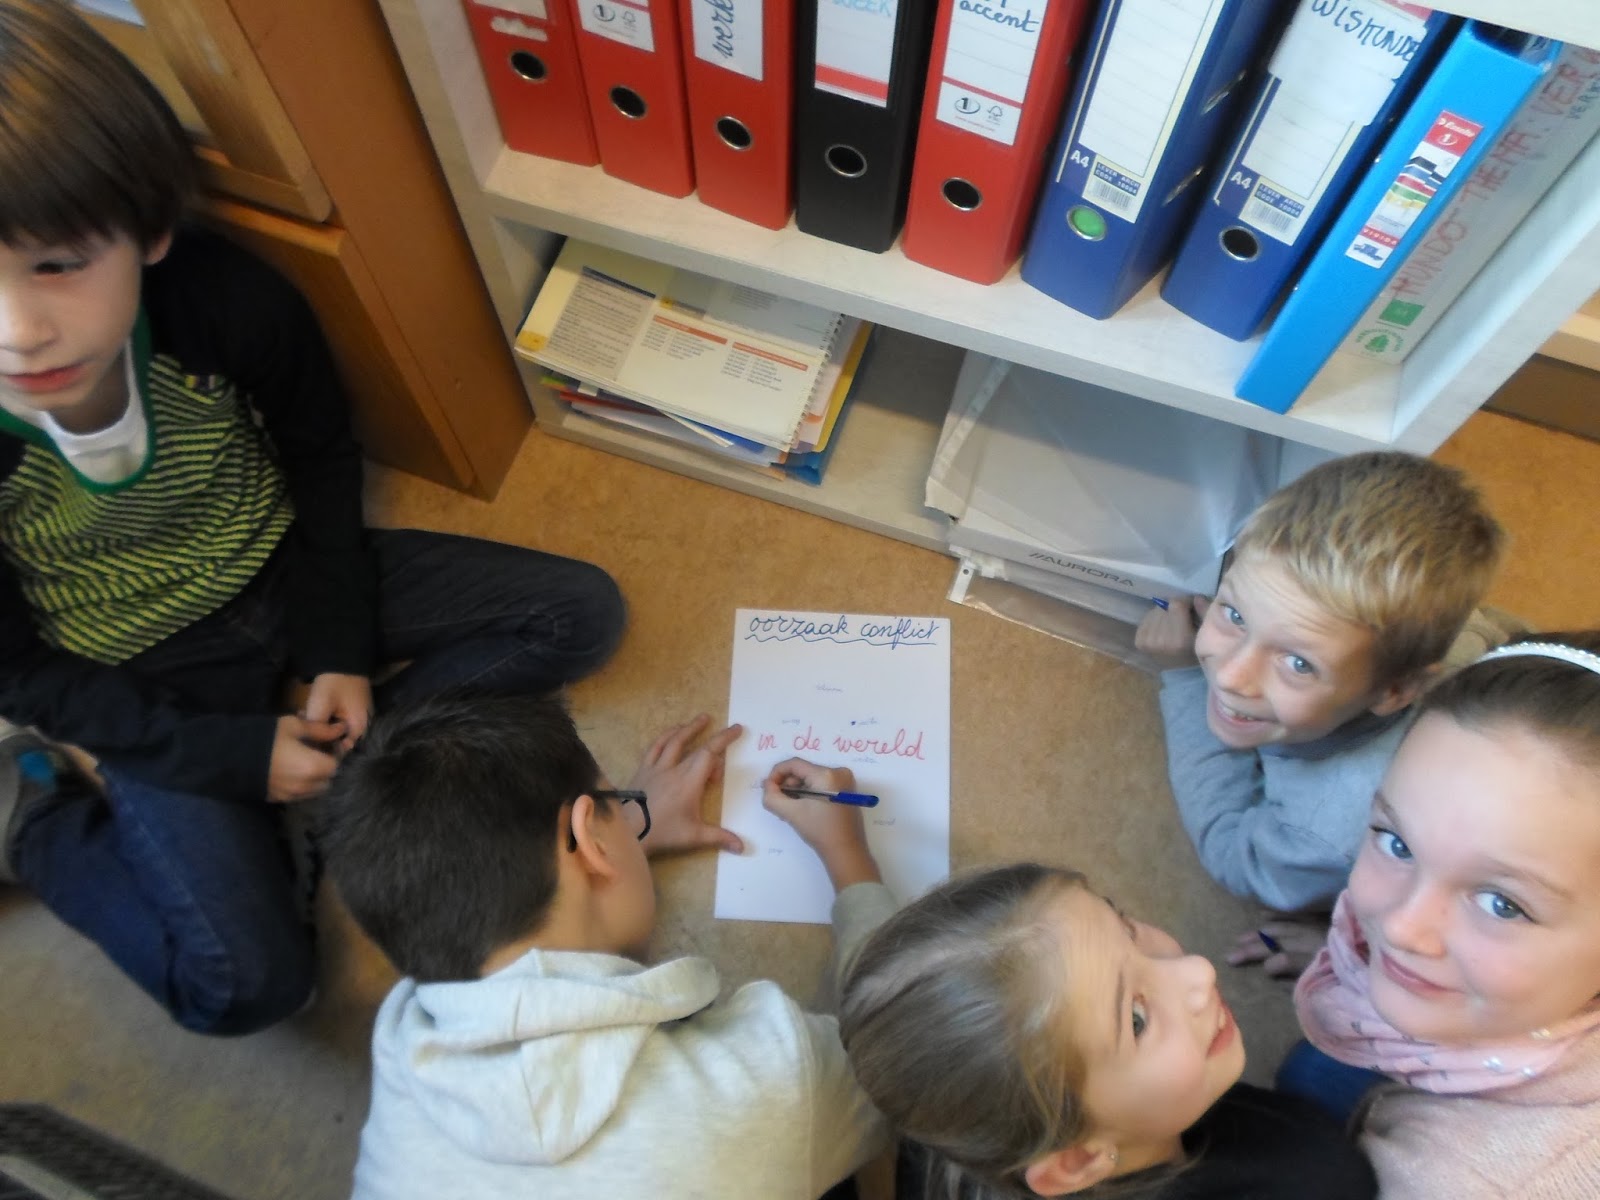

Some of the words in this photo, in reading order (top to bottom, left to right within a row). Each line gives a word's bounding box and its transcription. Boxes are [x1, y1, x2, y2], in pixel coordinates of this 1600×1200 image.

[960, 0, 1039, 32] accent
[1071, 149, 1090, 168] A4
[1231, 171, 1251, 190] A4
[750, 615, 850, 635] oorzaak
[861, 617, 939, 650] conflict
[757, 733, 777, 751] in
[793, 726, 821, 752] de
[833, 728, 925, 760] wereld
